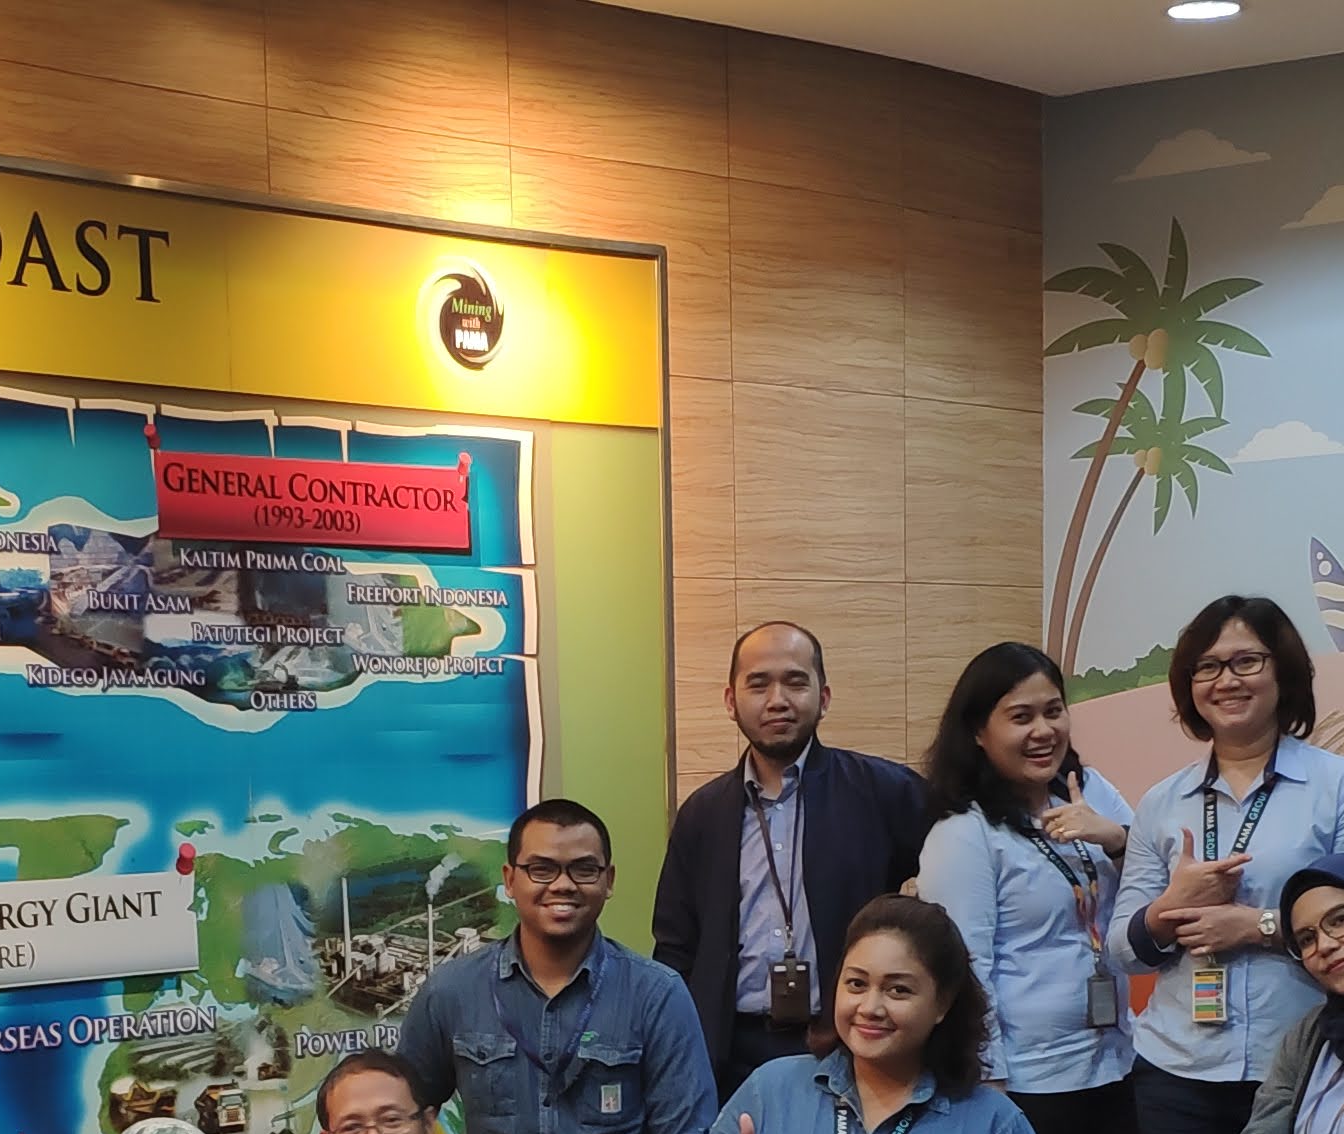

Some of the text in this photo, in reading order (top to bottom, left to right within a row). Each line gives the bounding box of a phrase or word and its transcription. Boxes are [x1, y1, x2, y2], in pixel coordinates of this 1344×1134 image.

[452, 297, 492, 323] Mining
[462, 316, 481, 329] with
[455, 328, 489, 352] PAMA
[163, 462, 458, 513] GENERAL CONTRACTOR
[255, 505, 361, 535] (1993-2003)
[180, 548, 346, 573] KALTIM PRIMA COAL
[87, 590, 191, 613] BUKIT ASAM
[346, 584, 508, 607] FREEPORT INDONESIA
[192, 622, 345, 647] BATUTEGI PROJECT
[27, 664, 205, 692] KIDECO JAYA AGUNG
[352, 654, 505, 677] WONOREJO PROJECT
[250, 691, 317, 710] OTHERS
[1236, 822, 1254, 851] PAMA
[65, 890, 163, 924] GIANT
[68, 1006, 217, 1045] OPERATION
[296, 1030, 370, 1056] POWER
